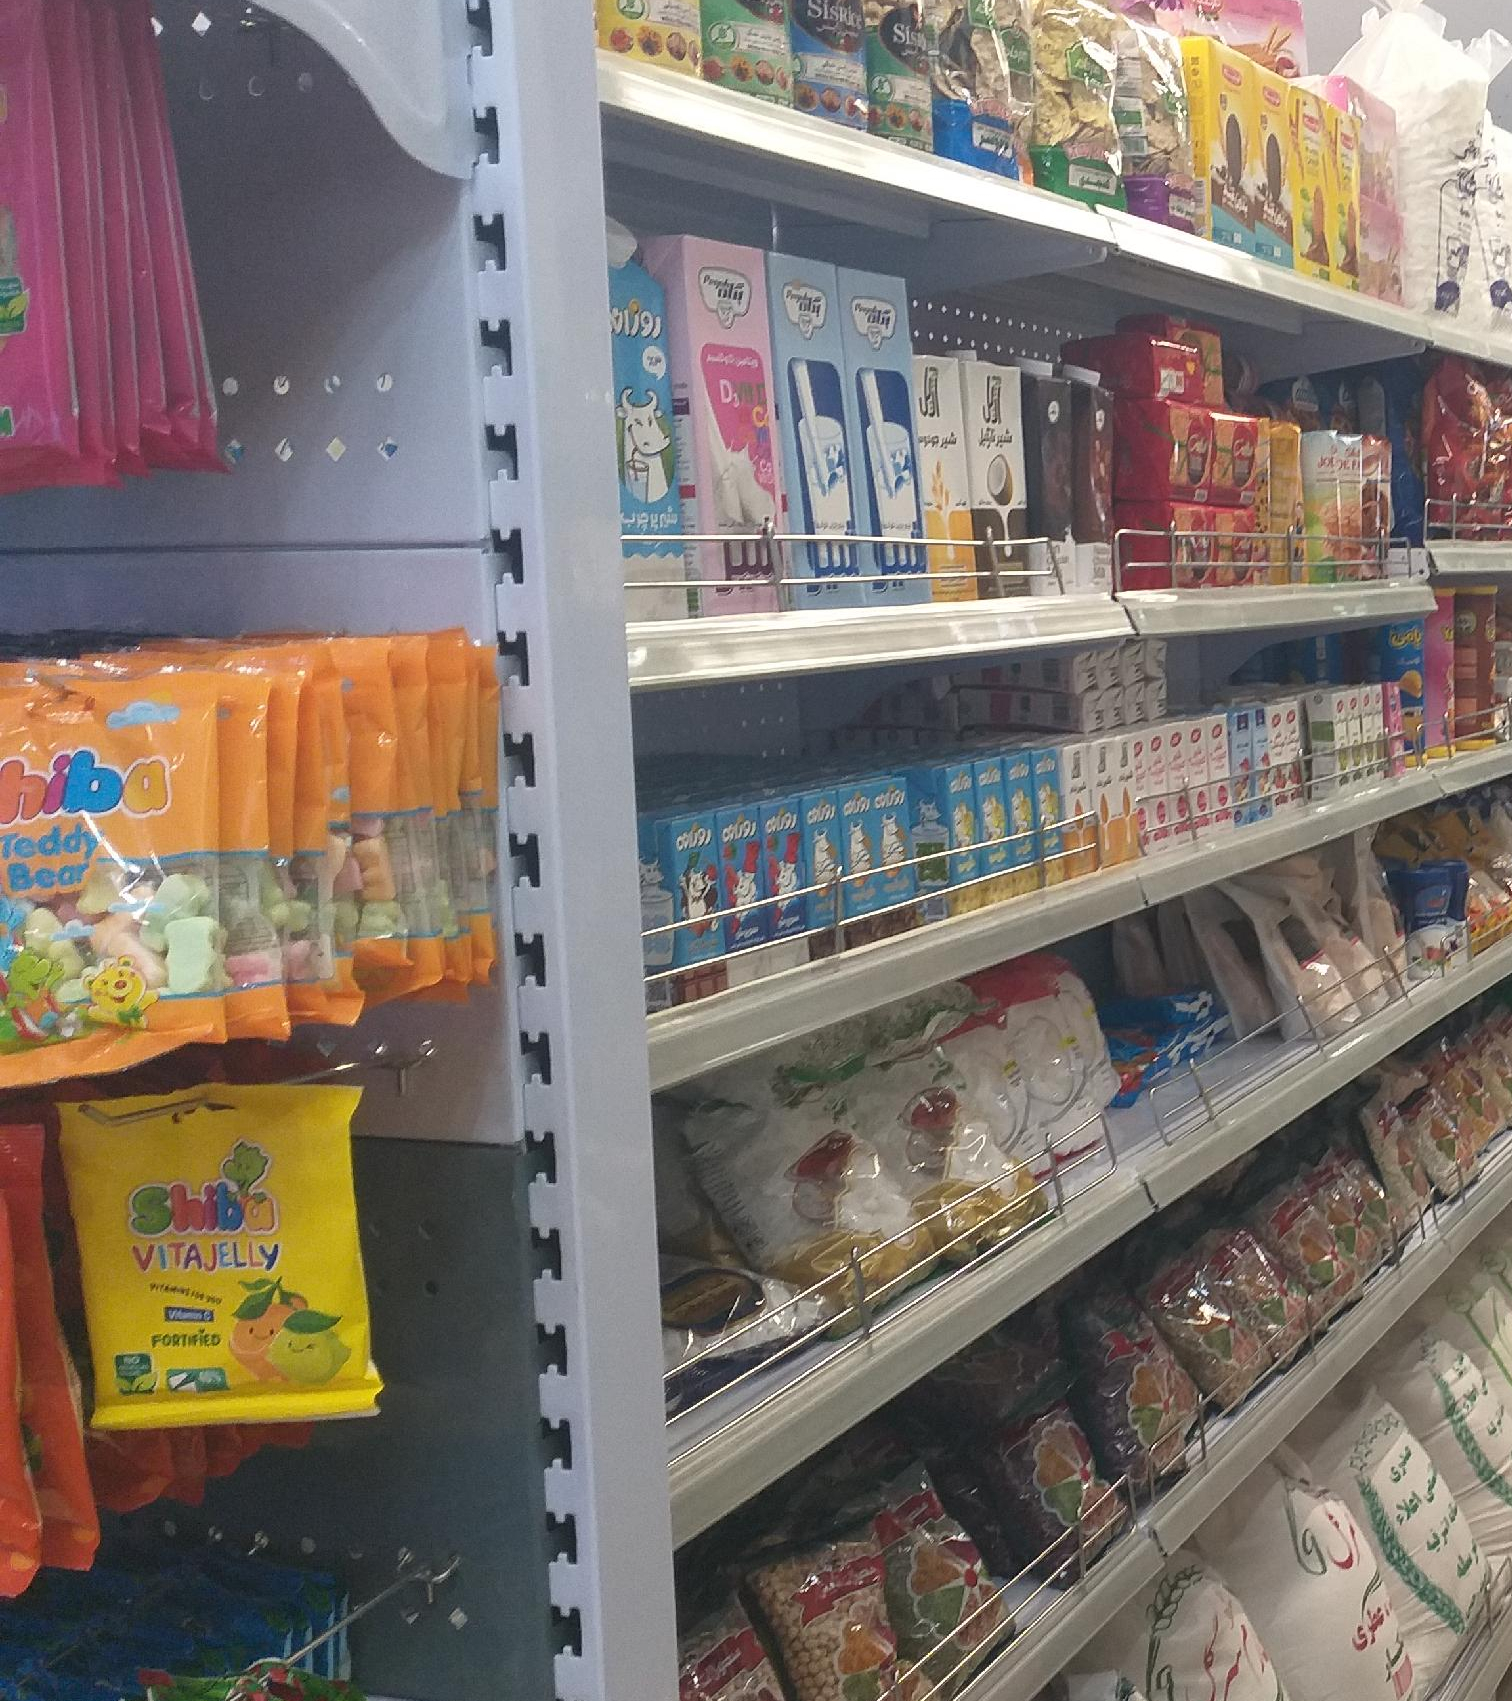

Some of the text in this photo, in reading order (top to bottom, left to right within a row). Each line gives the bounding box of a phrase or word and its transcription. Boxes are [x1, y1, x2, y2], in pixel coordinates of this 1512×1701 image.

[0, 824, 98, 860] Teddy
[7, 862, 90, 892] Bear
[130, 1181, 278, 1235] Shiba
[131, 1241, 281, 1273] VITAJELLY
